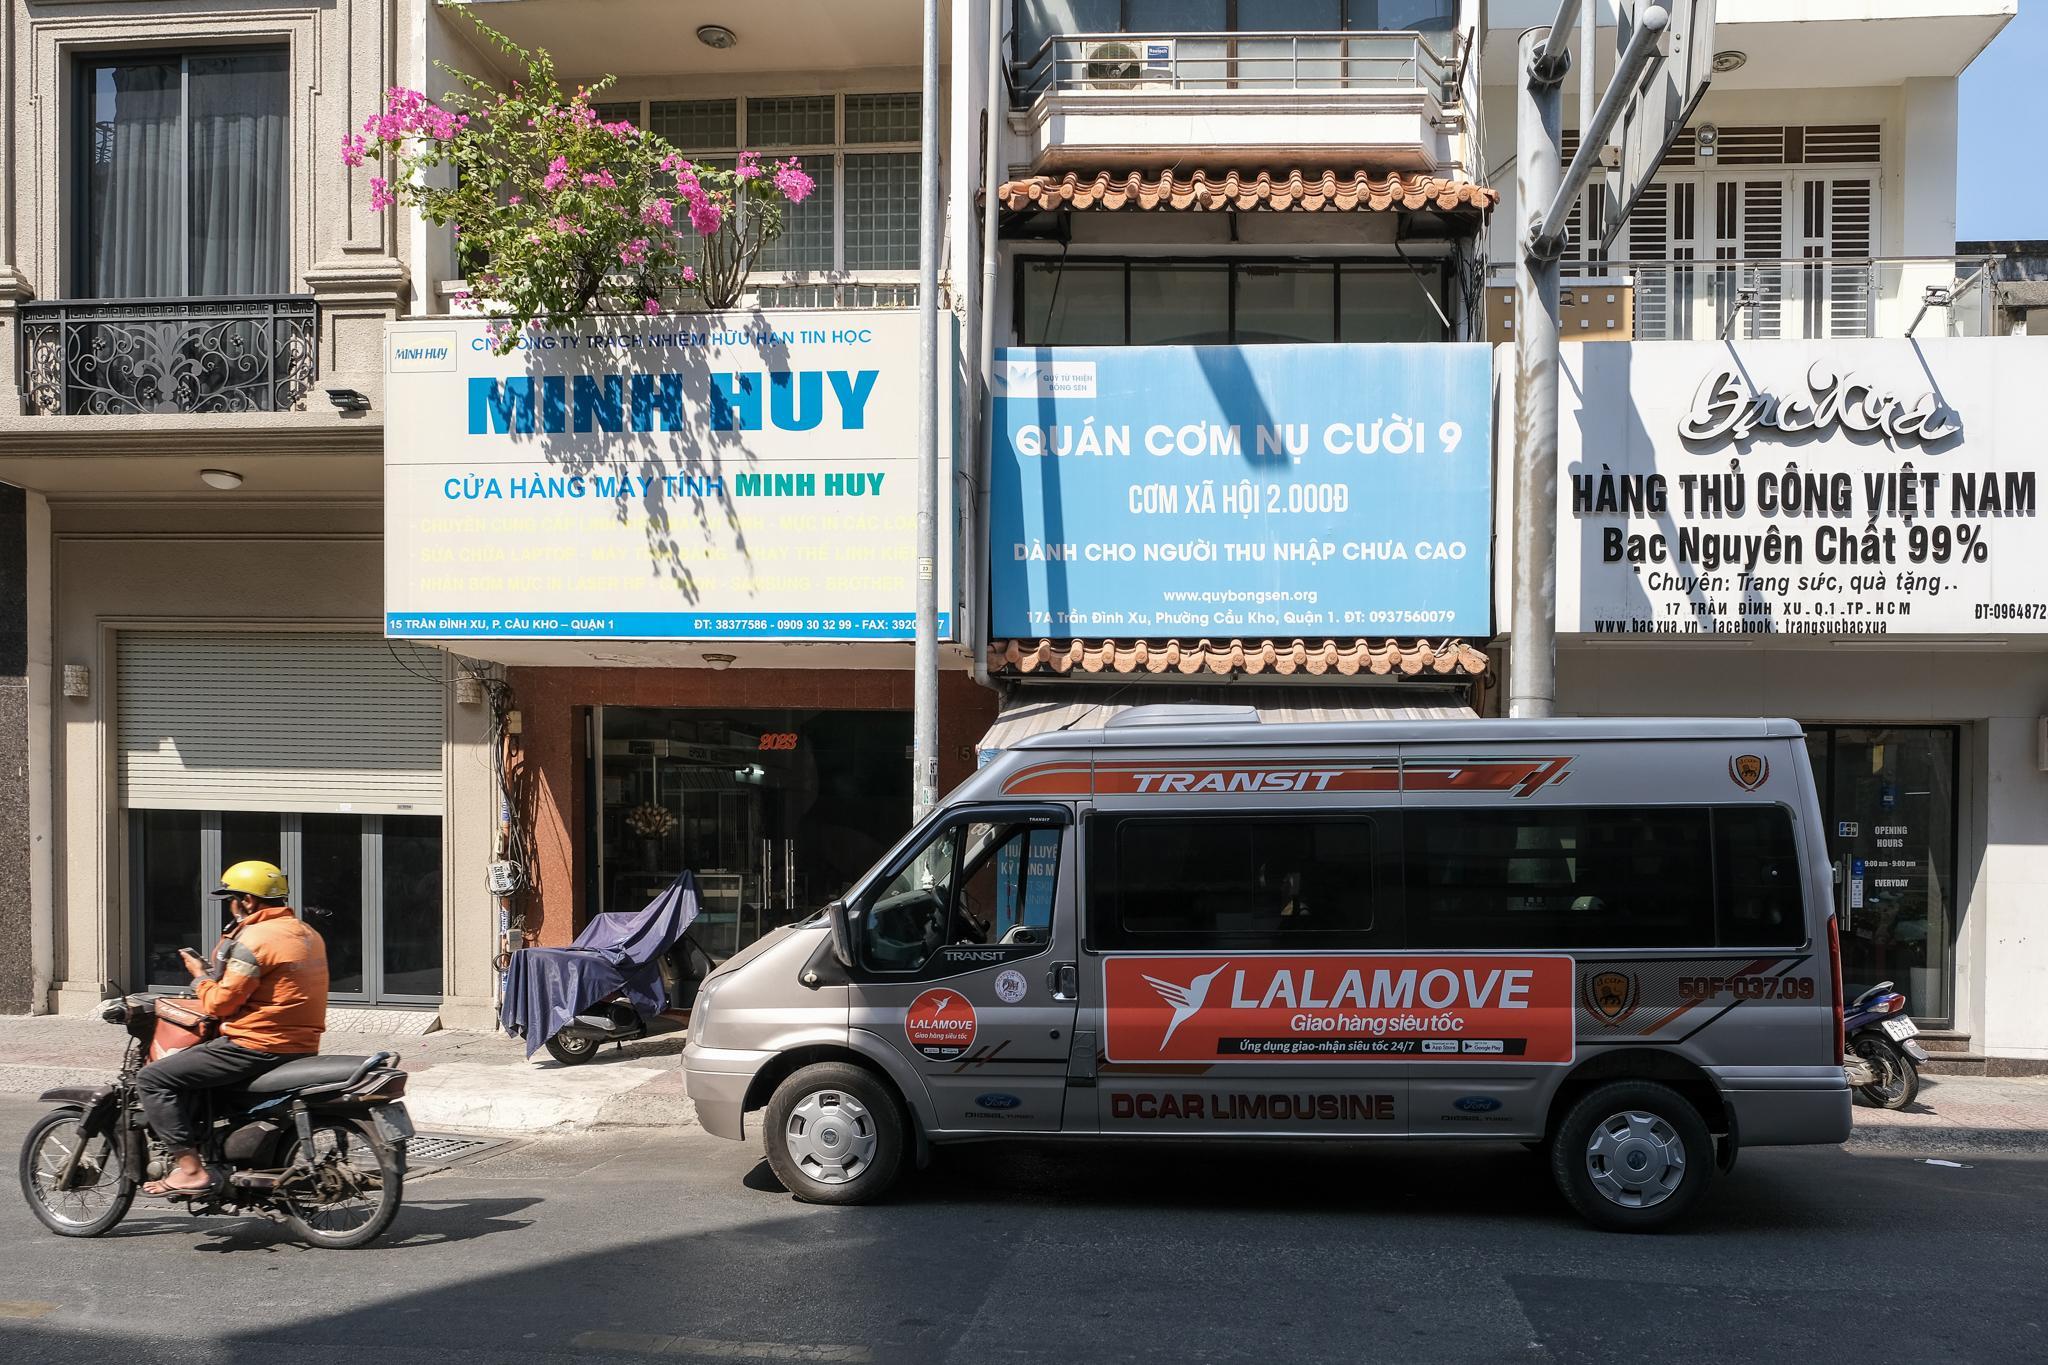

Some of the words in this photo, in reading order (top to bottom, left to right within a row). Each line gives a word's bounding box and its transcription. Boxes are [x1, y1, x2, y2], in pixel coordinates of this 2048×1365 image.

[561, 335, 585, 349] TY
[586, 331, 642, 349] TRÁCH
[648, 331, 706, 350] NHIỆM
[711, 329, 750, 346] HỮU
[756, 331, 794, 348] HẠN
[800, 330, 825, 344] TIN
[832, 329, 872, 347] HỌC
[395, 348, 423, 360] MINH
[425, 347, 449, 361] HUY
[468, 373, 683, 435] MINH
[710, 370, 880, 431] HUY
[1015, 416, 1131, 457] QUÁN
[1144, 420, 1241, 457] CƠM
[1256, 423, 1309, 464] NỤ
[1323, 413, 1425, 455] CƯỜI
[1438, 421, 1463, 453] 9
[444, 473, 502, 500] CỬA
[510, 472, 586, 499] HÀNG
[595, 472, 651, 498] MÁY
[661, 470, 723, 498] TÍNH
[735, 473, 815, 497] MINH
[824, 473, 885, 496] HUY
[1572, 463, 1668, 514] HÀNG
[1679, 458, 1746, 514] THỦ
[1757, 461, 1852, 514] CÔNG
[1863, 461, 1940, 523] VIỆT
[1951, 471, 2037, 514] NAM
[1128, 483, 1178, 514] CƠM
[1184, 479, 1217, 514] XÃ
[1222, 478, 1260, 519] HỘI
[1266, 483, 1349, 514] 2.000Đ
[1013, 538, 1077, 561] DÀNH
[1084, 543, 1137, 562] CHO
[1143, 538, 1218, 562] NGƯỜI
[1224, 543, 1266, 561] THU
[1273, 537, 1336, 565] NHẬP
[1342, 540, 1409, 561] CHƯA
[1414, 541, 1467, 561] CAO
[1603, 527, 1668, 573] Bạc
[1679, 525, 1803, 572] Nguyên
[1815, 515, 1896, 565] Chất
[1908, 523, 1989, 565] 99%
[1647, 571, 1731, 595] Chuyên:
[1737, 572, 1790, 595] Trang
[1797, 570, 1843, 594] sức,
[1850, 571, 1887, 595] quà
[1163, 590, 1318, 604] www.quybongsen.org
[1027, 611, 1054, 624] 17A
[1057, 608, 1088, 624] Trần
[1091, 610, 1124, 624] Đình
[1128, 611, 1152, 626] Xu,
[1155, 610, 1209, 627] Phường
[1213, 608, 1243, 625] Cầu
[1248, 611, 1280, 626] Kho,
[1284, 610, 1323, 627] Quận
[1327, 611, 1340, 623] 1.
[1344, 611, 1365, 623] ĐT:
[1665, 602, 1681, 616] 17
[389, 619, 402, 630] 15
[405, 616, 437, 629] TRẦN
[439, 616, 467, 629] ĐÌNH
[470, 619, 489, 631] XU,
[492, 619, 502, 629] P.
[504, 616, 530, 629] CẦU
[533, 619, 559, 629] KHO
[571, 618, 604, 632] QUẬN
[609, 619, 615, 629] 1
[694, 619, 712, 630] ĐT:
[715, 619, 768, 630] 38377586
[777, 619, 803, 630] 0909
[807, 619, 820, 630] 30
[823, 619, 836, 630] 32
[839, 619, 852, 630] 99
[862, 619, 889, 630] FAX:
[1785, 617, 1888, 635] trangsucbacxua
[758, 732, 799, 751] 2023
[953, 745, 972, 761] 15
[1132, 771, 1345, 793] TRANSIT
[1874, 826, 1908, 835] OPENING
[1876, 838, 1903, 848] HOURS
[1874, 879, 1909, 887] EVERYDAY
[944, 951, 1006, 961] TRANSIT
[1230, 968, 1534, 1009] LALAMOVE
[1678, 976, 1815, 1000] 50F-037.09
[910, 1019, 974, 1030] LALAMOVE
[1290, 1013, 1336, 1032] Giao
[1337, 1012, 1388, 1035] hàng
[1388, 1013, 1430, 1032] siêu
[1430, 1011, 1464, 1032] tốc
[914, 1032, 929, 1040] Giao
[929, 1032, 944, 1041] hàng
[1239, 1037, 1261, 1054] Ứng
[1262, 1040, 1291, 1054] dụng
[1292, 1039, 1346, 1054] giao-nhận
[1347, 1039, 1370, 1052] siêu
[1371, 1039, 1389, 1052] tốc
[1390, 1041, 1415, 1053] 24/7
[1111, 1093, 1204, 1119] DCAR
[1210, 1094, 1395, 1120] LIMOUSINE
